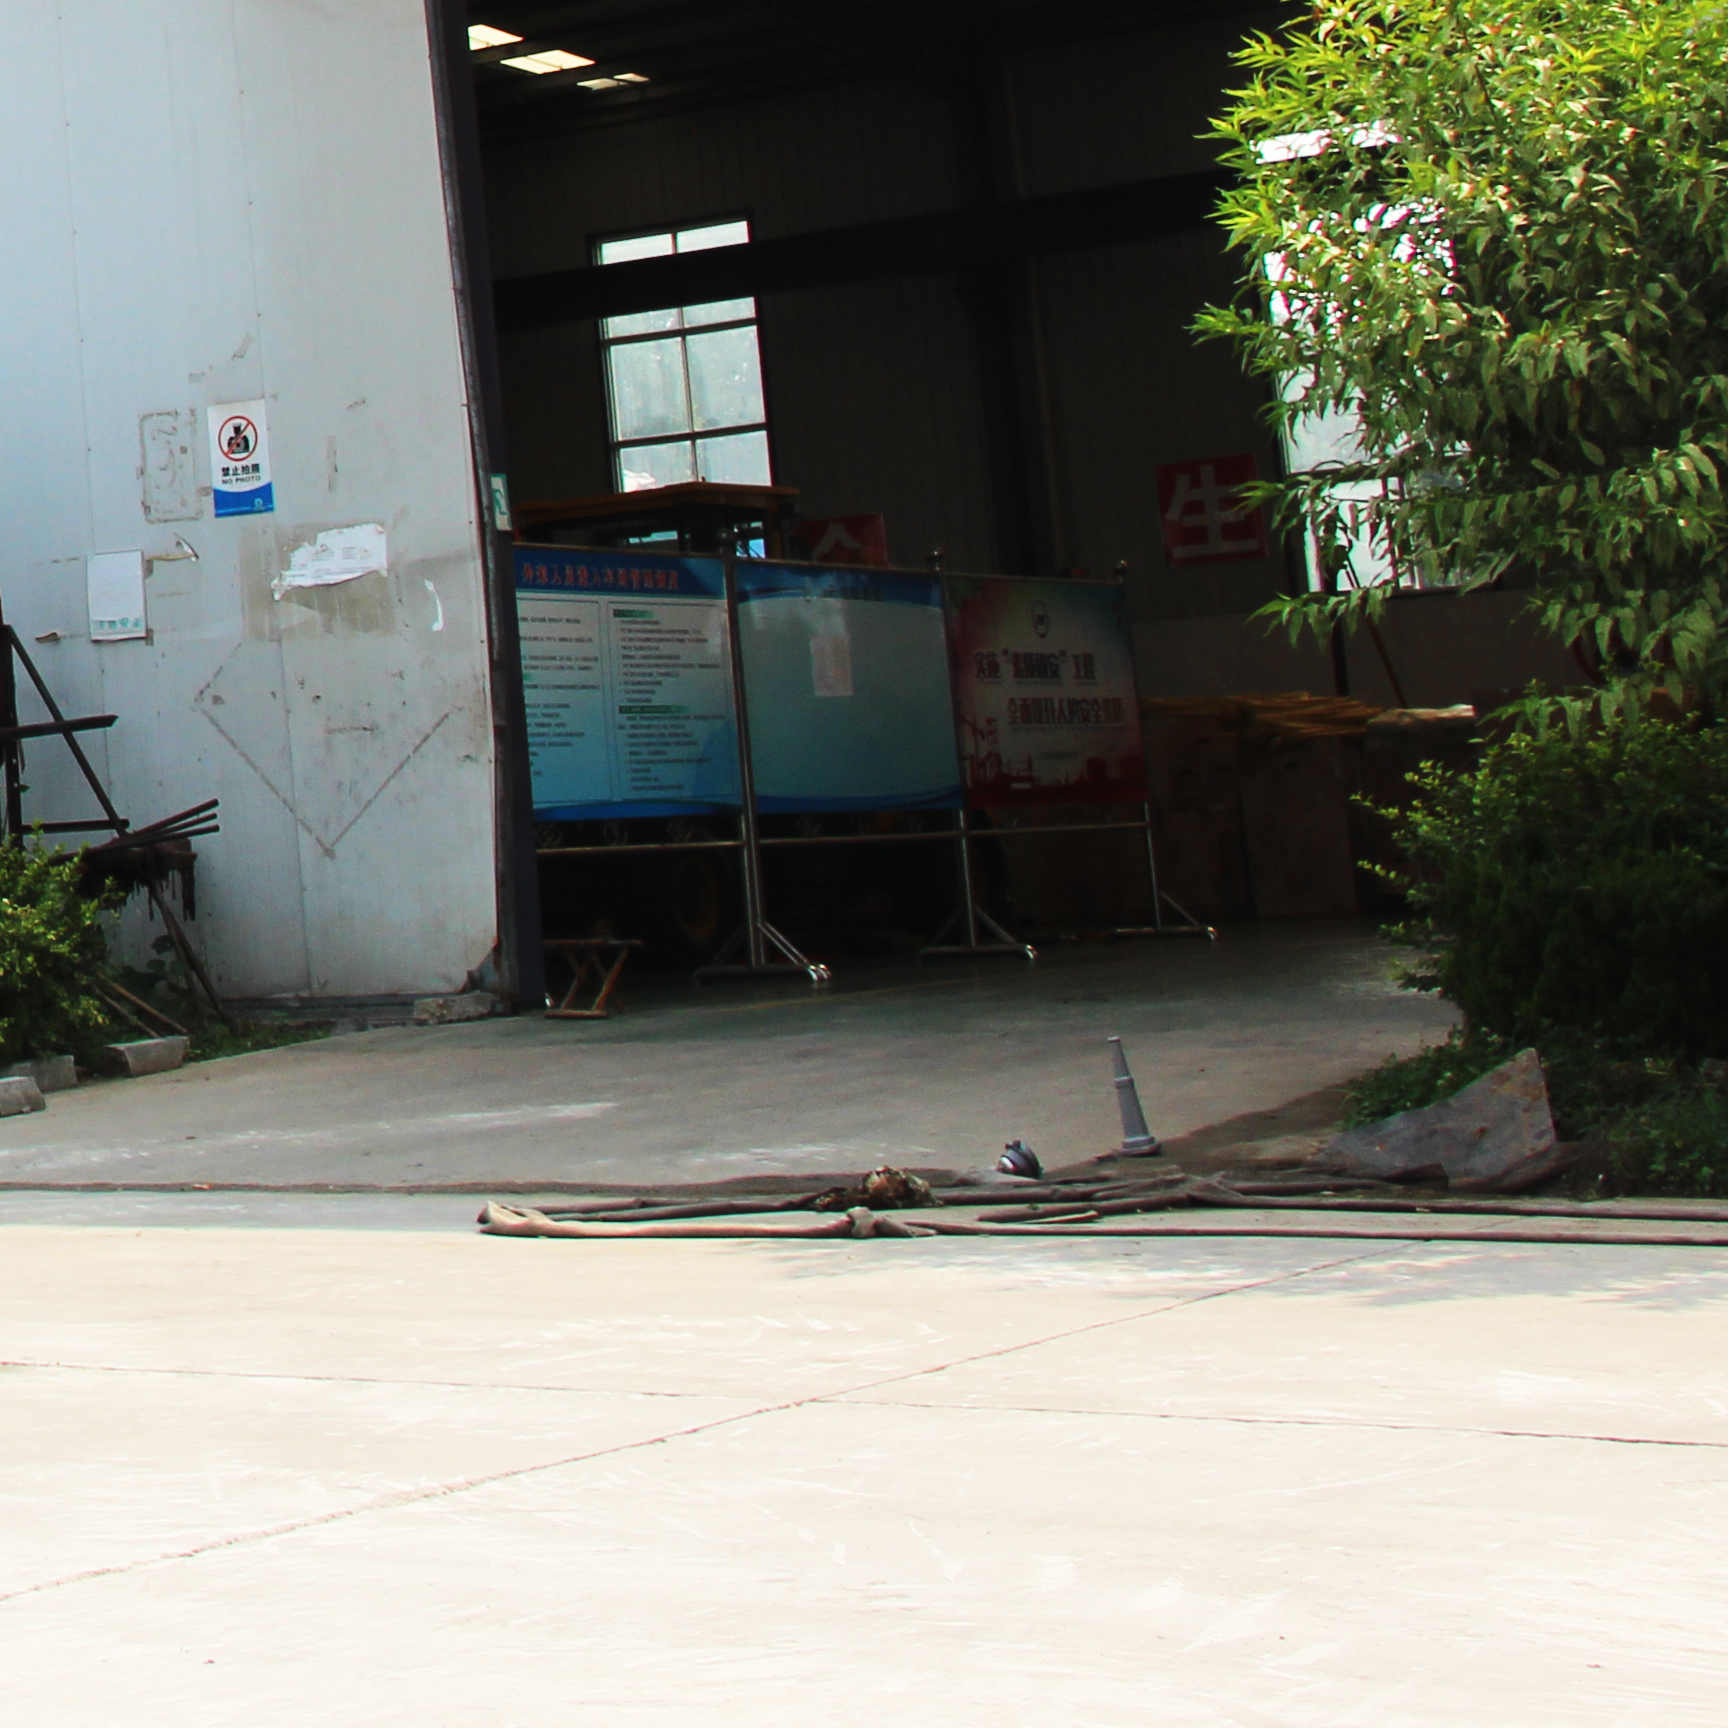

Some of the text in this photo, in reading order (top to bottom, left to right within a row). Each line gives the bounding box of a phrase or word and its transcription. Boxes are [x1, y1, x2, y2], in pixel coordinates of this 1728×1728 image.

[222, 463, 260, 477] 禁止拍照
[236, 475, 261, 483] PHOTO
[1165, 465, 1258, 556] 生
